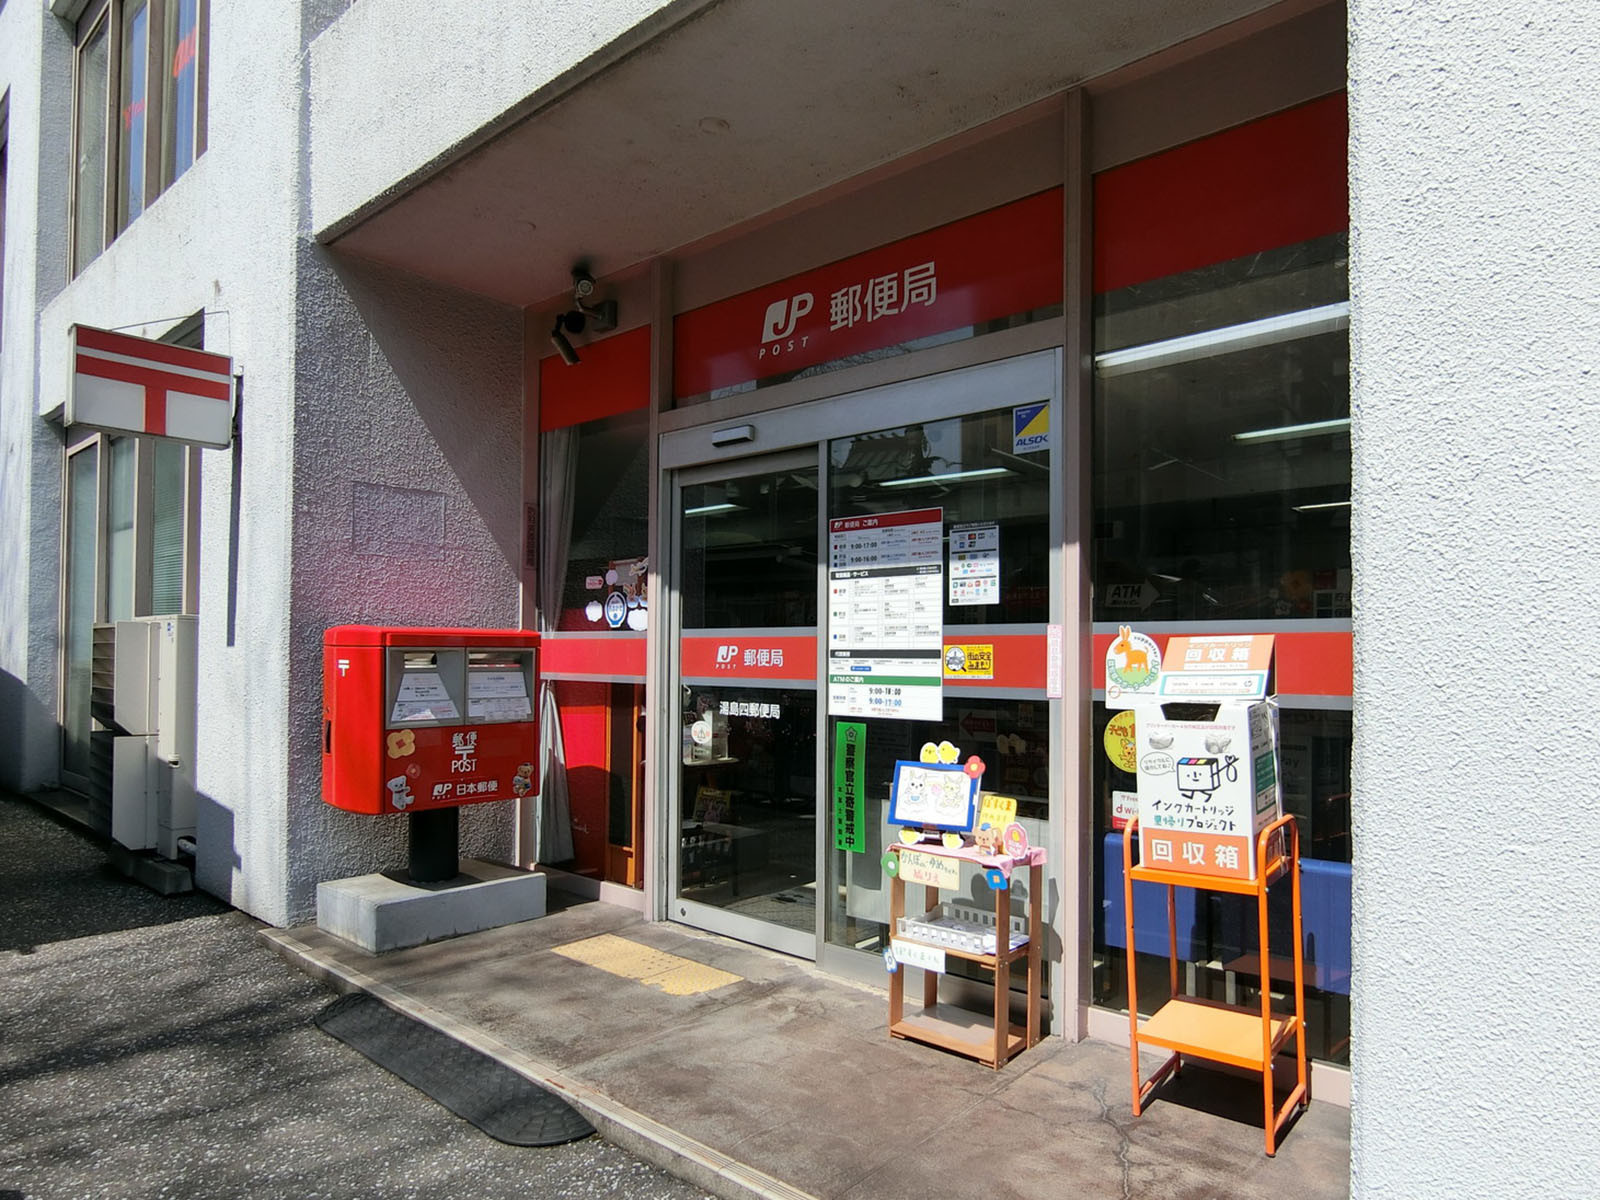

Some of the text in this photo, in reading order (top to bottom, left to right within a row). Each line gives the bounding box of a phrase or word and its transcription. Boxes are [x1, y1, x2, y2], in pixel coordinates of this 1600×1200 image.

[830, 261, 937, 332] 郵便局
[758, 336, 809, 360] POST
[744, 649, 784, 668] 郵便局
[1184, 647, 1251, 662] 回収箱
[719, 701, 780, 719] 湯島四郵便局
[452, 731, 478, 748] 郵便
[451, 758, 478, 773] POST
[456, 780, 498, 796] 日本郵便
[844, 743, 856, 848] 警察官立寄警戒中
[1152, 799, 1235, 816] インクカートリッジ
[1153, 815, 1237, 831] 里帰りプロジェクト
[1151, 838, 1239, 870] 回収箱
